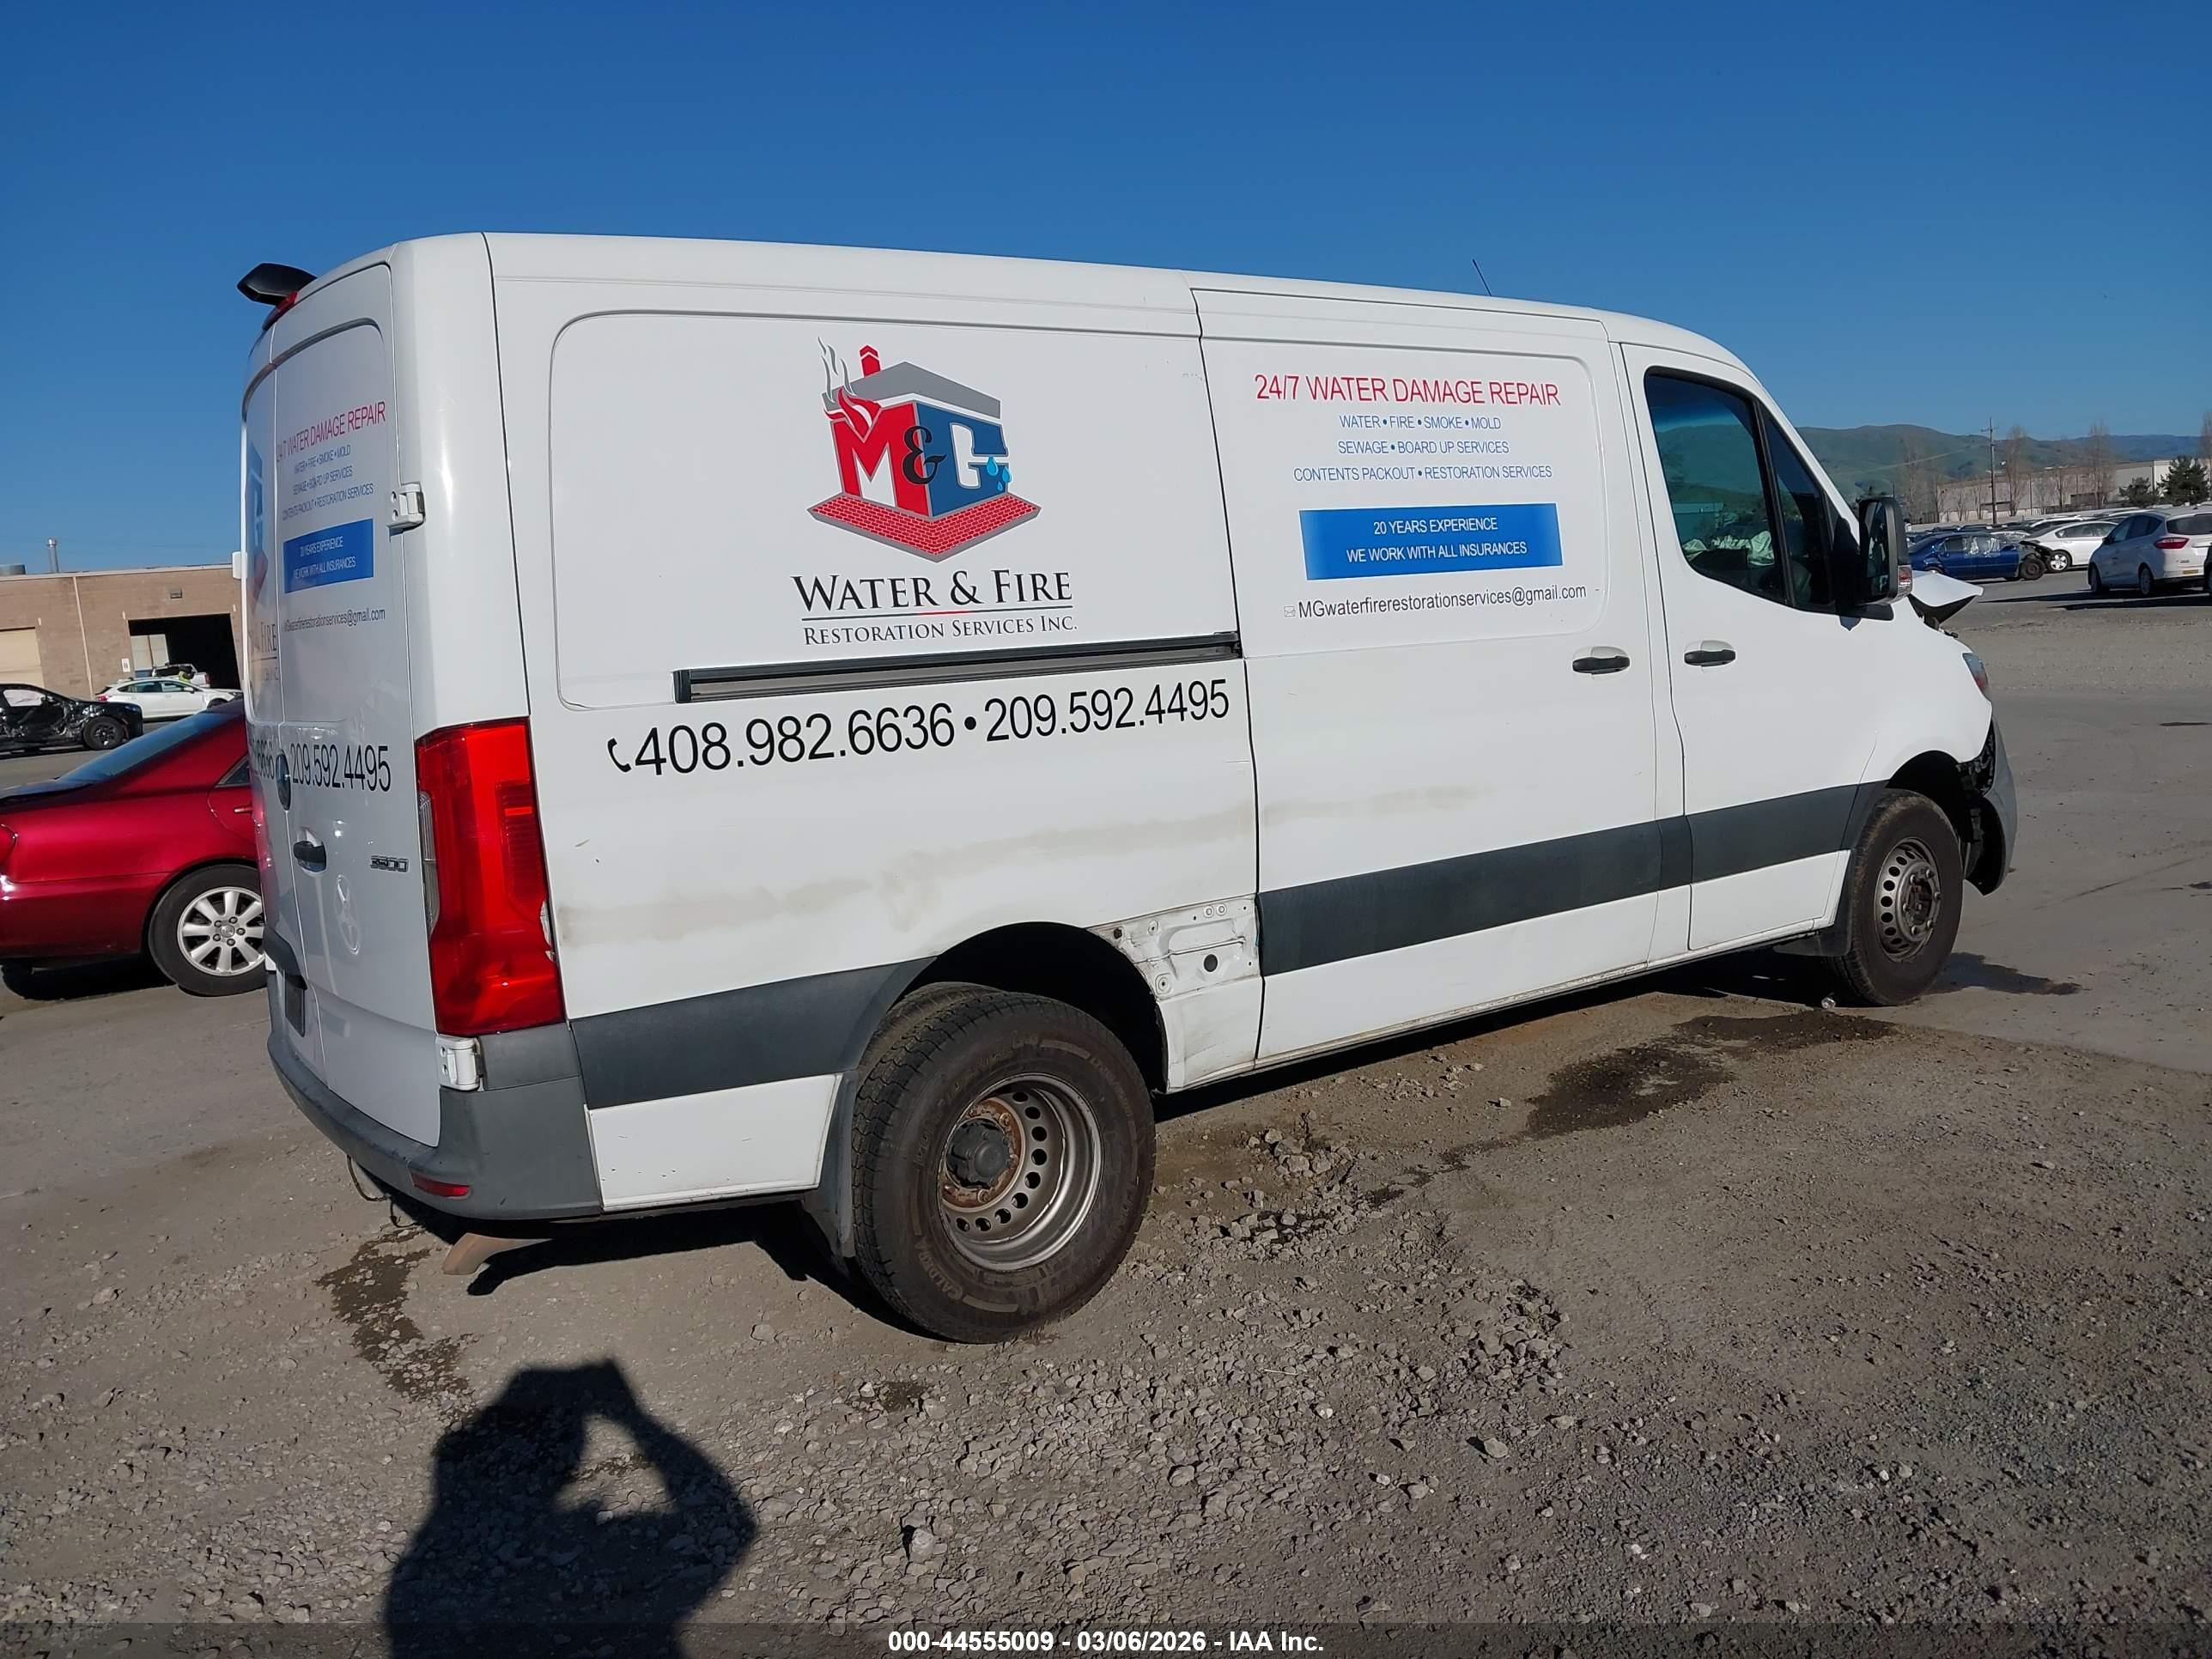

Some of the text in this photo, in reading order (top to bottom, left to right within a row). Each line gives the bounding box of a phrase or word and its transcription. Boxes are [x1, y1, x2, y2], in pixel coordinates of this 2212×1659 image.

[1255, 374, 1561, 406] 24/7 WATER DAMAGE REPAIR
[311, 414, 345, 446] DAMAGE
[348, 400, 386, 433] REPAIR
[1340, 415, 1501, 429] WATER FIRE SMOKE MOLD
[1338, 441, 1509, 454] SEWAGE BOARD UP SERVICES
[1293, 465, 1553, 481] CONTENTS PACKOUT RESTORATION SERVICES
[1374, 517, 1498, 535] 20 YEARS EXPERIENCE
[1346, 541, 1527, 562] WE WORK WITH ALL INSURANCES
[790, 569, 1073, 611] WATER & FIRE
[1298, 585, 1586, 619] MGwaterfirerestorationservices@gmail.com
[804, 615, 1077, 645] RESTORATION SERVICES INC.
[634, 678, 1230, 777] 408.982.6636 209.592.4495
[290, 742, 392, 792] 209.592.4495
